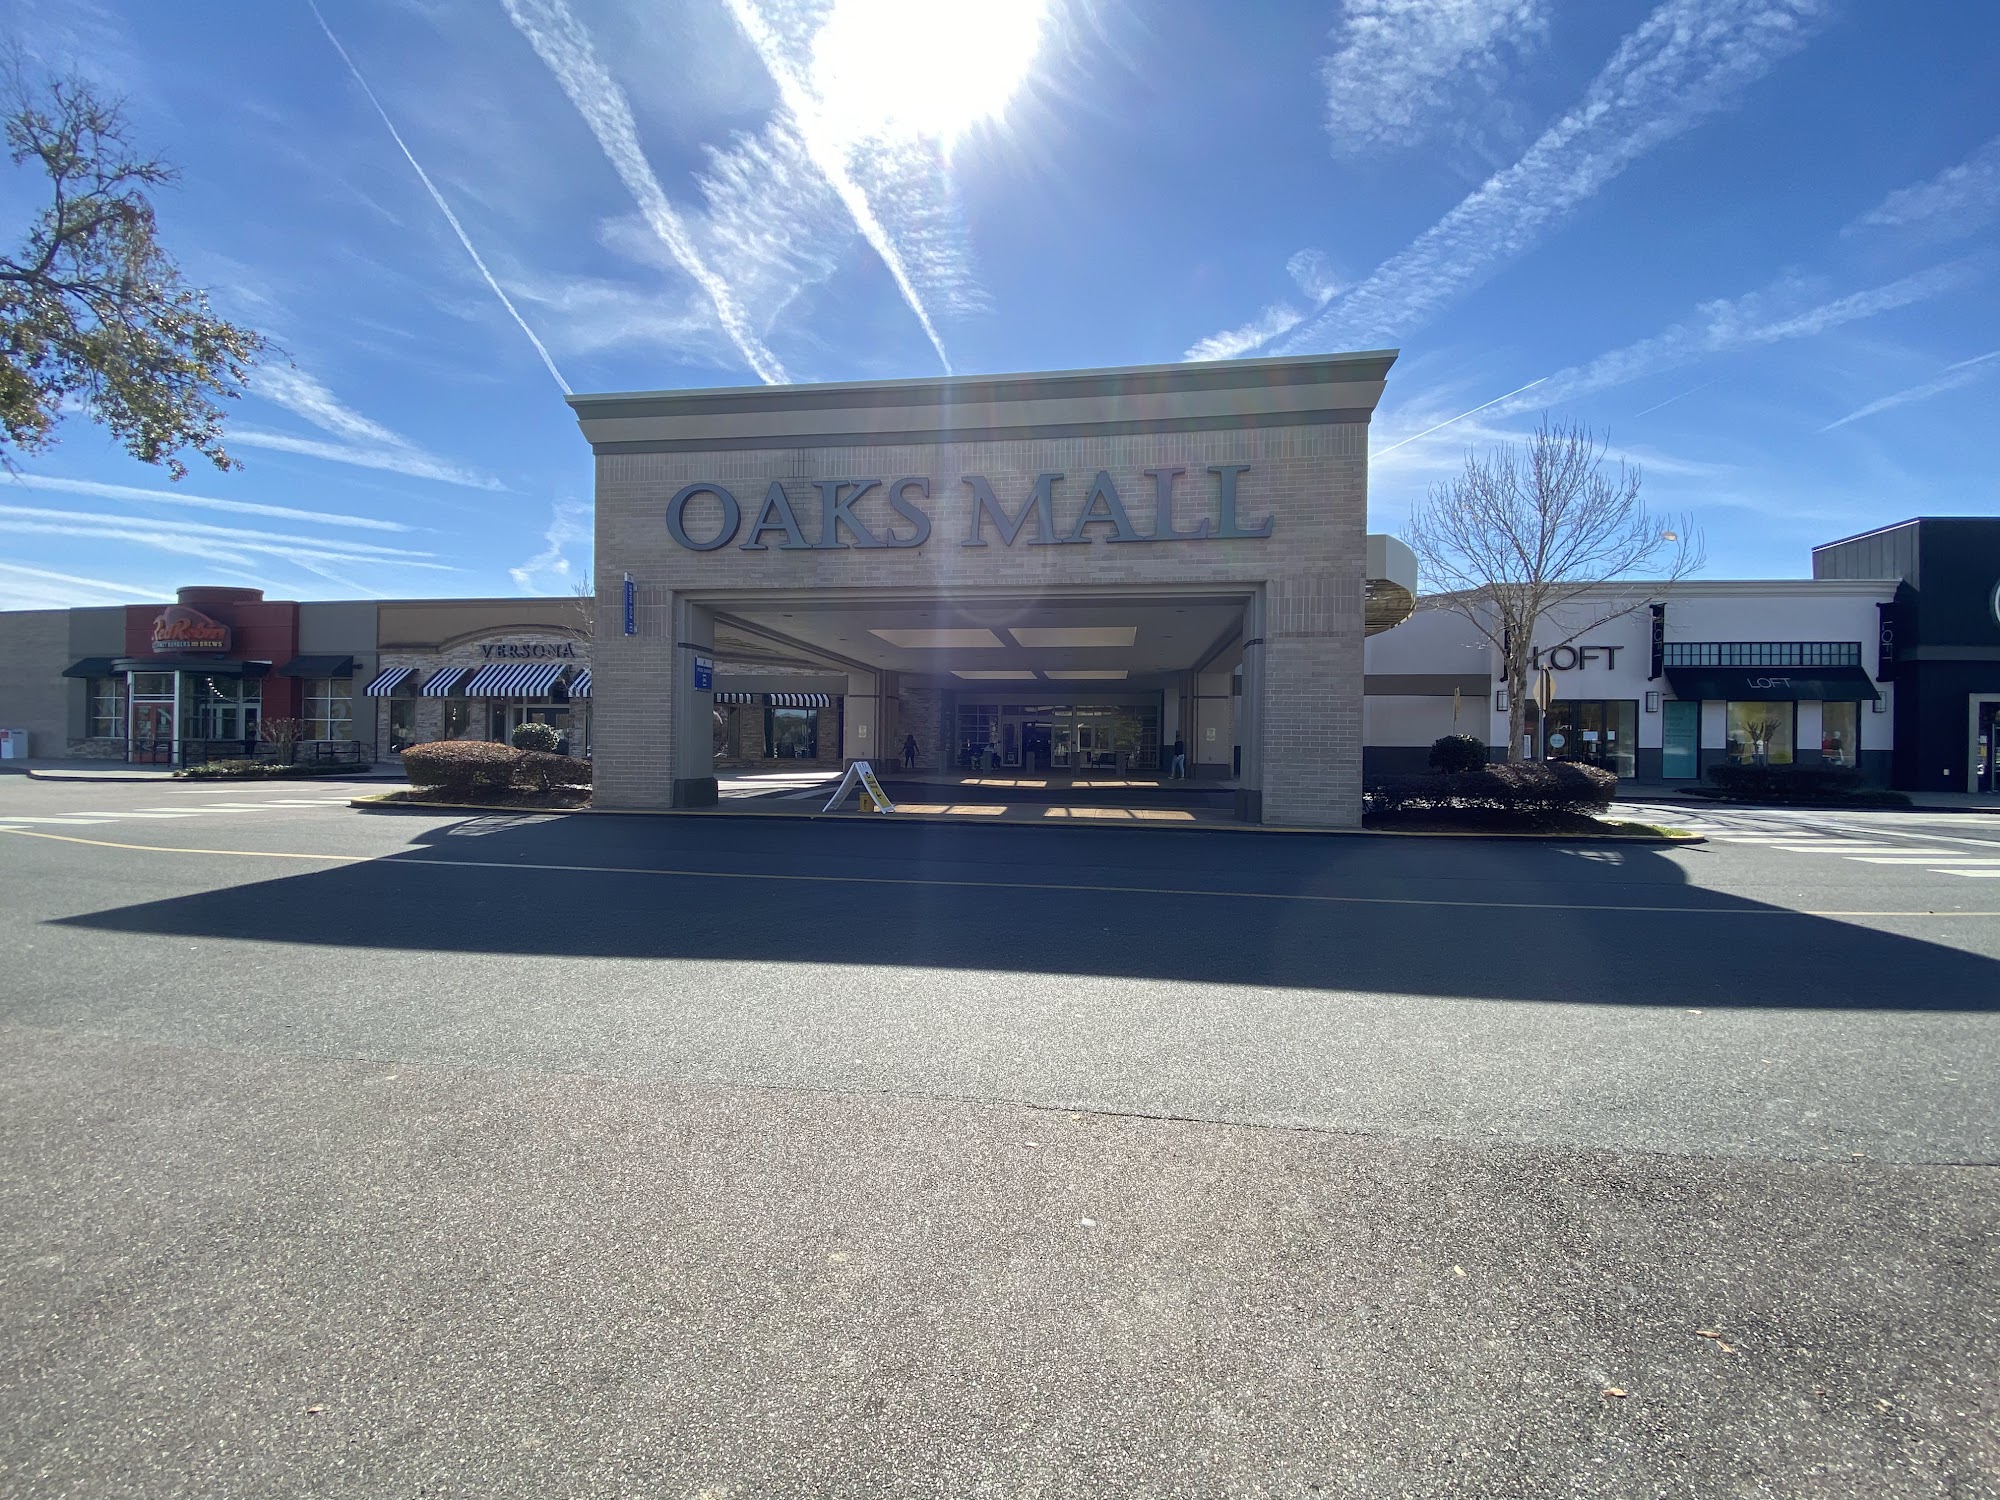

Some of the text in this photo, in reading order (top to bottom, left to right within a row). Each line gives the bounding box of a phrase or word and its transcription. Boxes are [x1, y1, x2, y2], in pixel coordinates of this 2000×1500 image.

[665, 464, 1275, 552] OAKS MALL
[481, 643, 575, 658] VERSONA
[1881, 620, 1894, 662] LOFT
[1532, 645, 1625, 671] LOFT
[1747, 677, 1791, 689] LOFT
